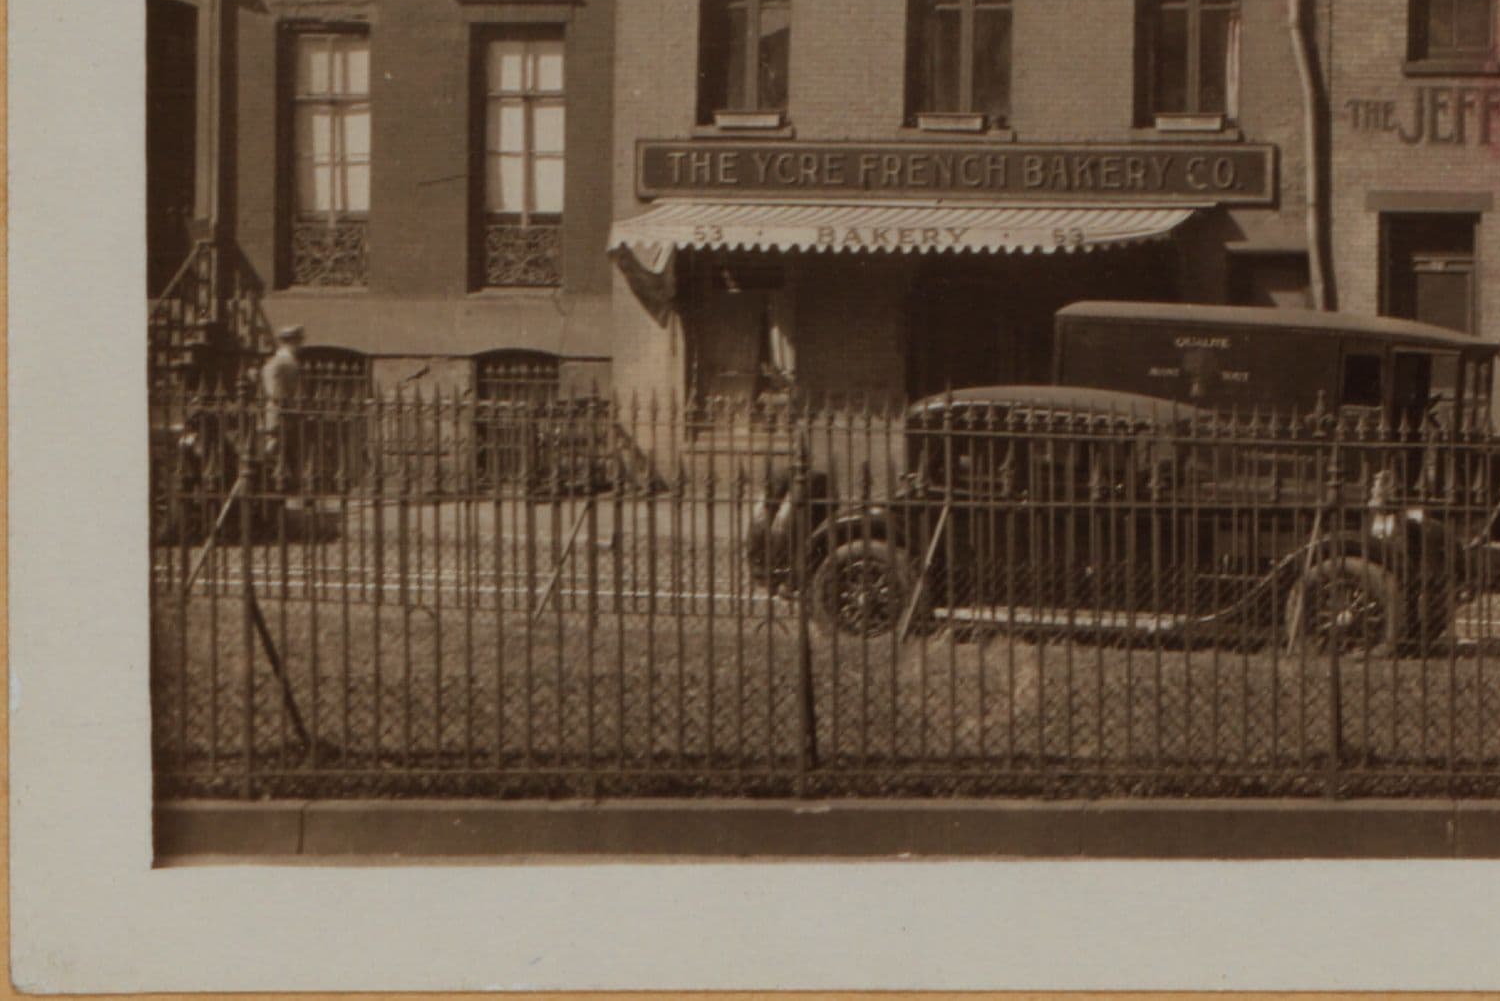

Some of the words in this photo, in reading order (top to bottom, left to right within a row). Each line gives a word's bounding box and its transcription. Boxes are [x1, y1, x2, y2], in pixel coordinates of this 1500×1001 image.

[1347, 99, 1398, 132] THE
[667, 151, 738, 186] THE
[858, 153, 1008, 188] FRENCH
[1023, 154, 1169, 189] BAKERY
[694, 224, 723, 242] 53
[817, 225, 970, 246] BAKERY
